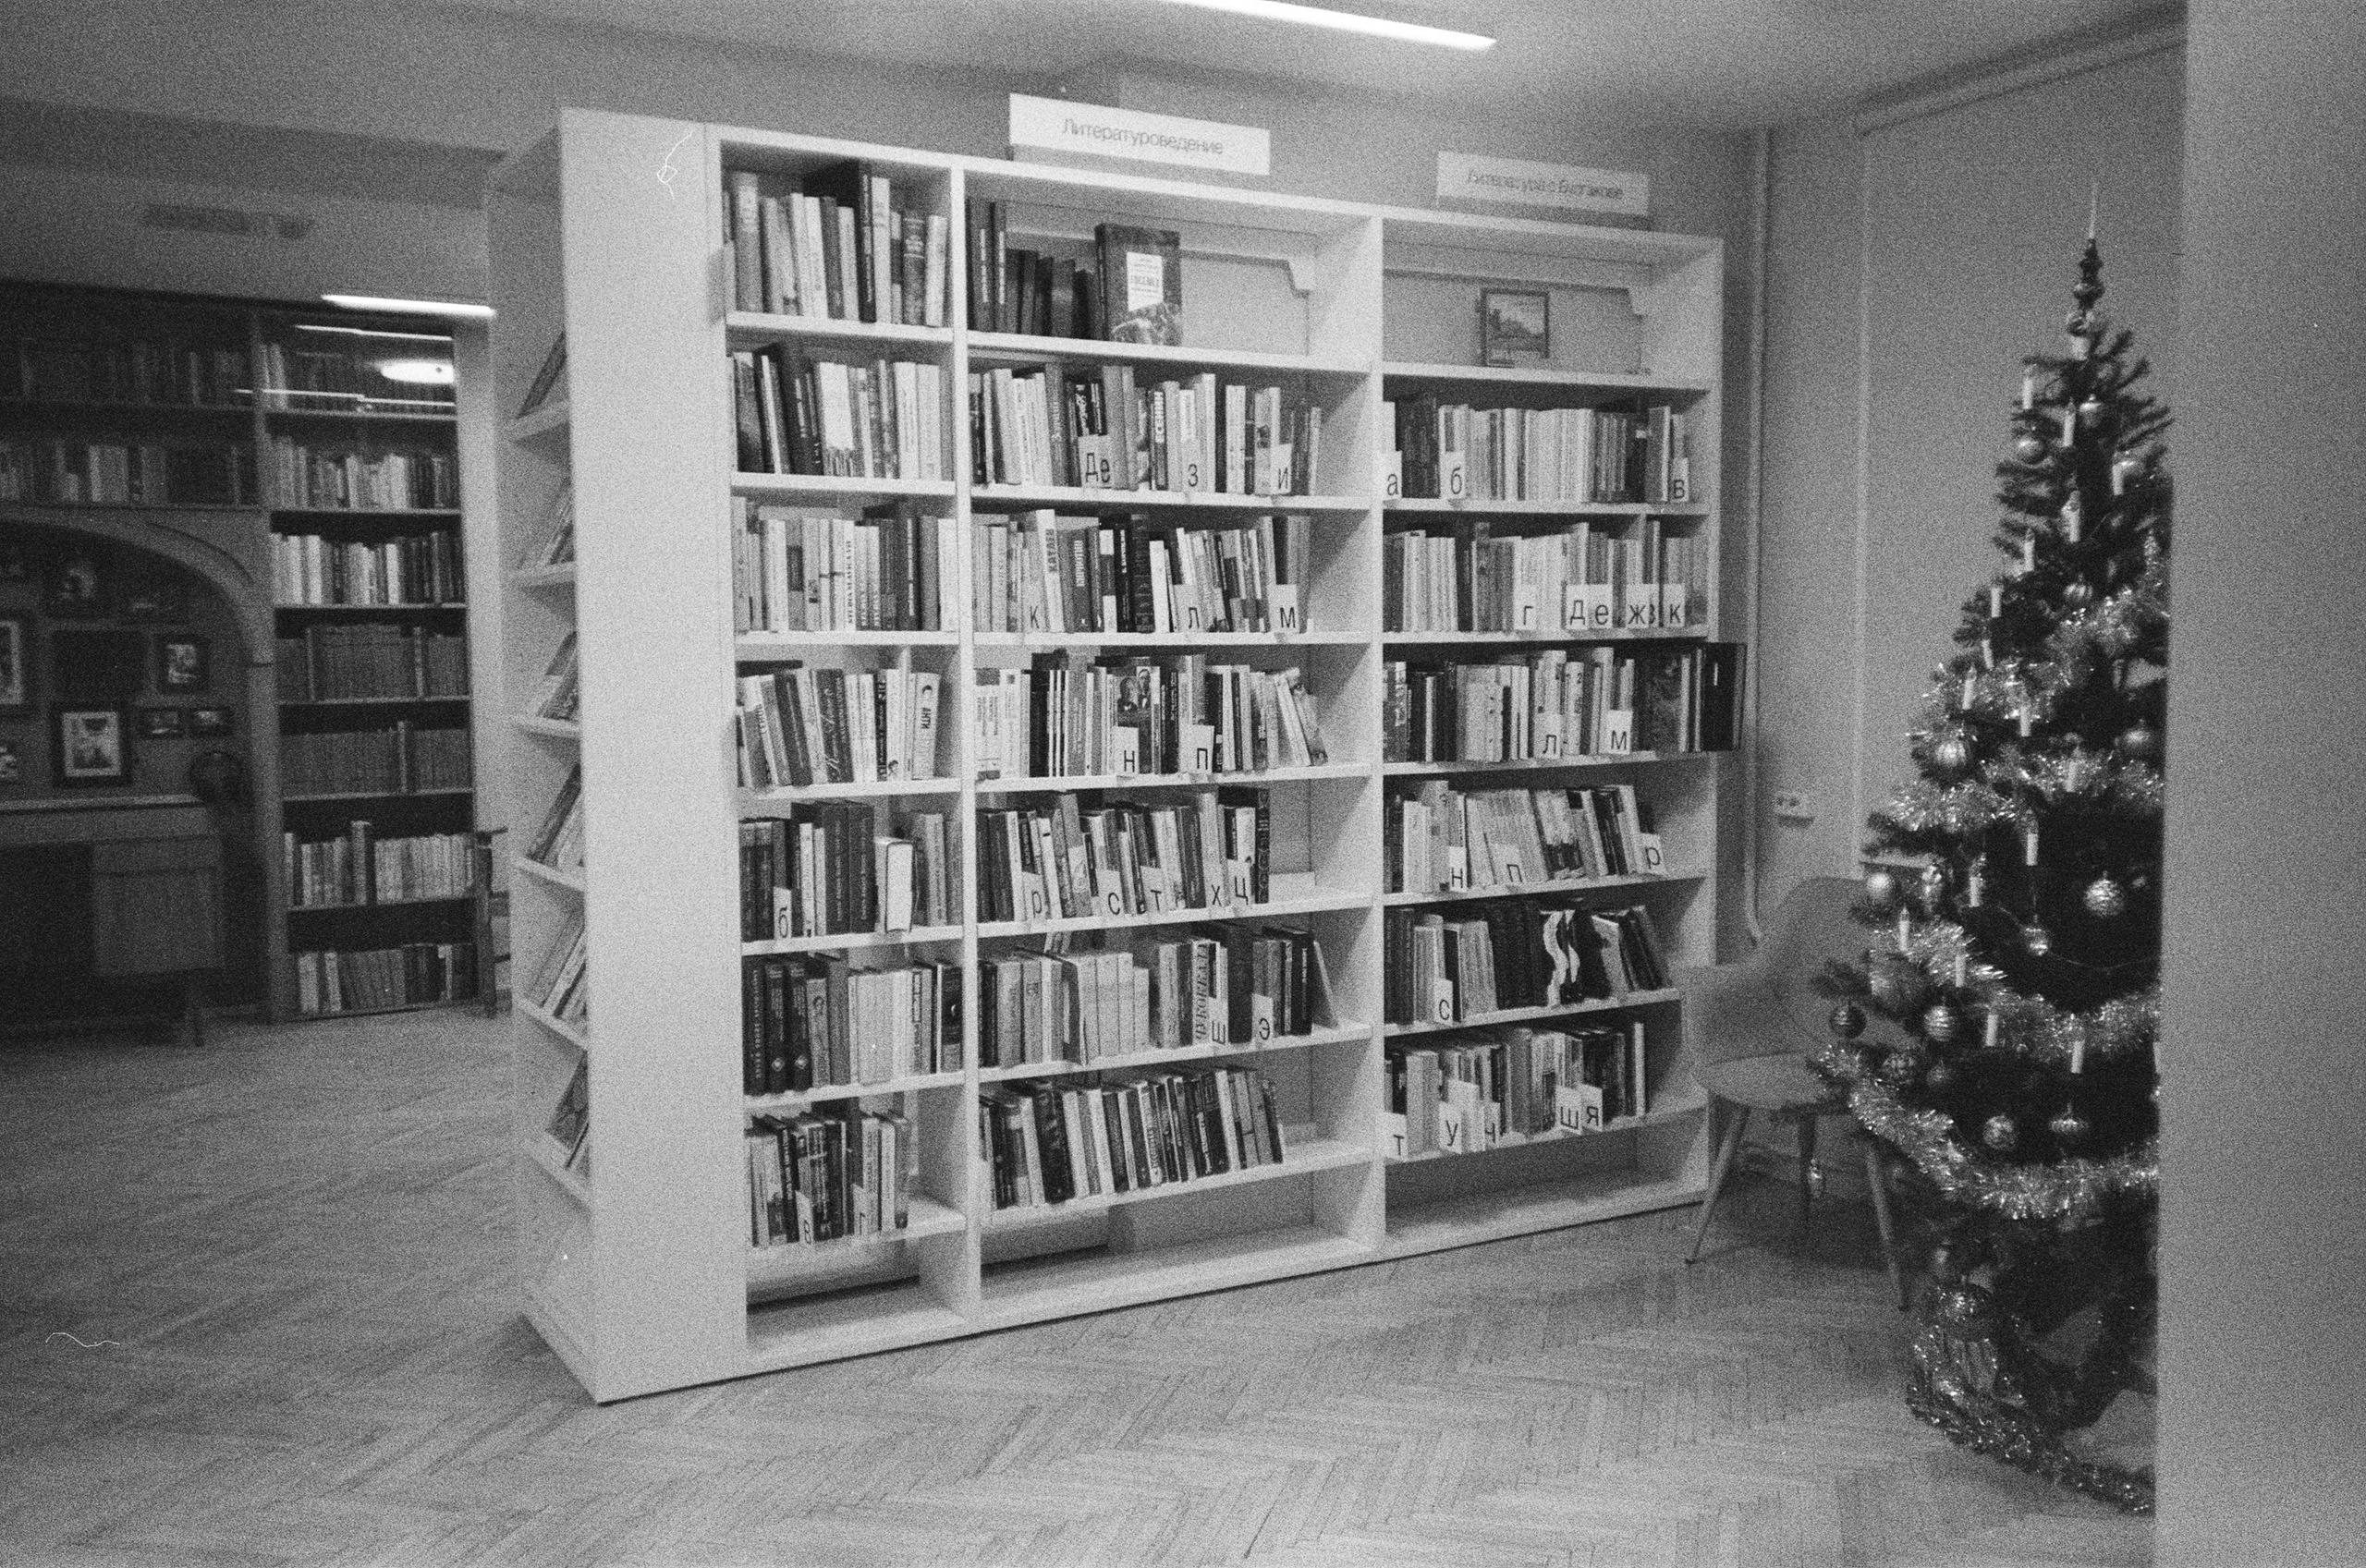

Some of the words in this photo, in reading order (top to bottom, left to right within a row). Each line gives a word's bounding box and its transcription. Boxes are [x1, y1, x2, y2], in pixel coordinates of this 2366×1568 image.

[1062, 118, 1225, 155] Литературоведение
[1387, 472, 1399, 496] а
[1451, 467, 1462, 495] б
